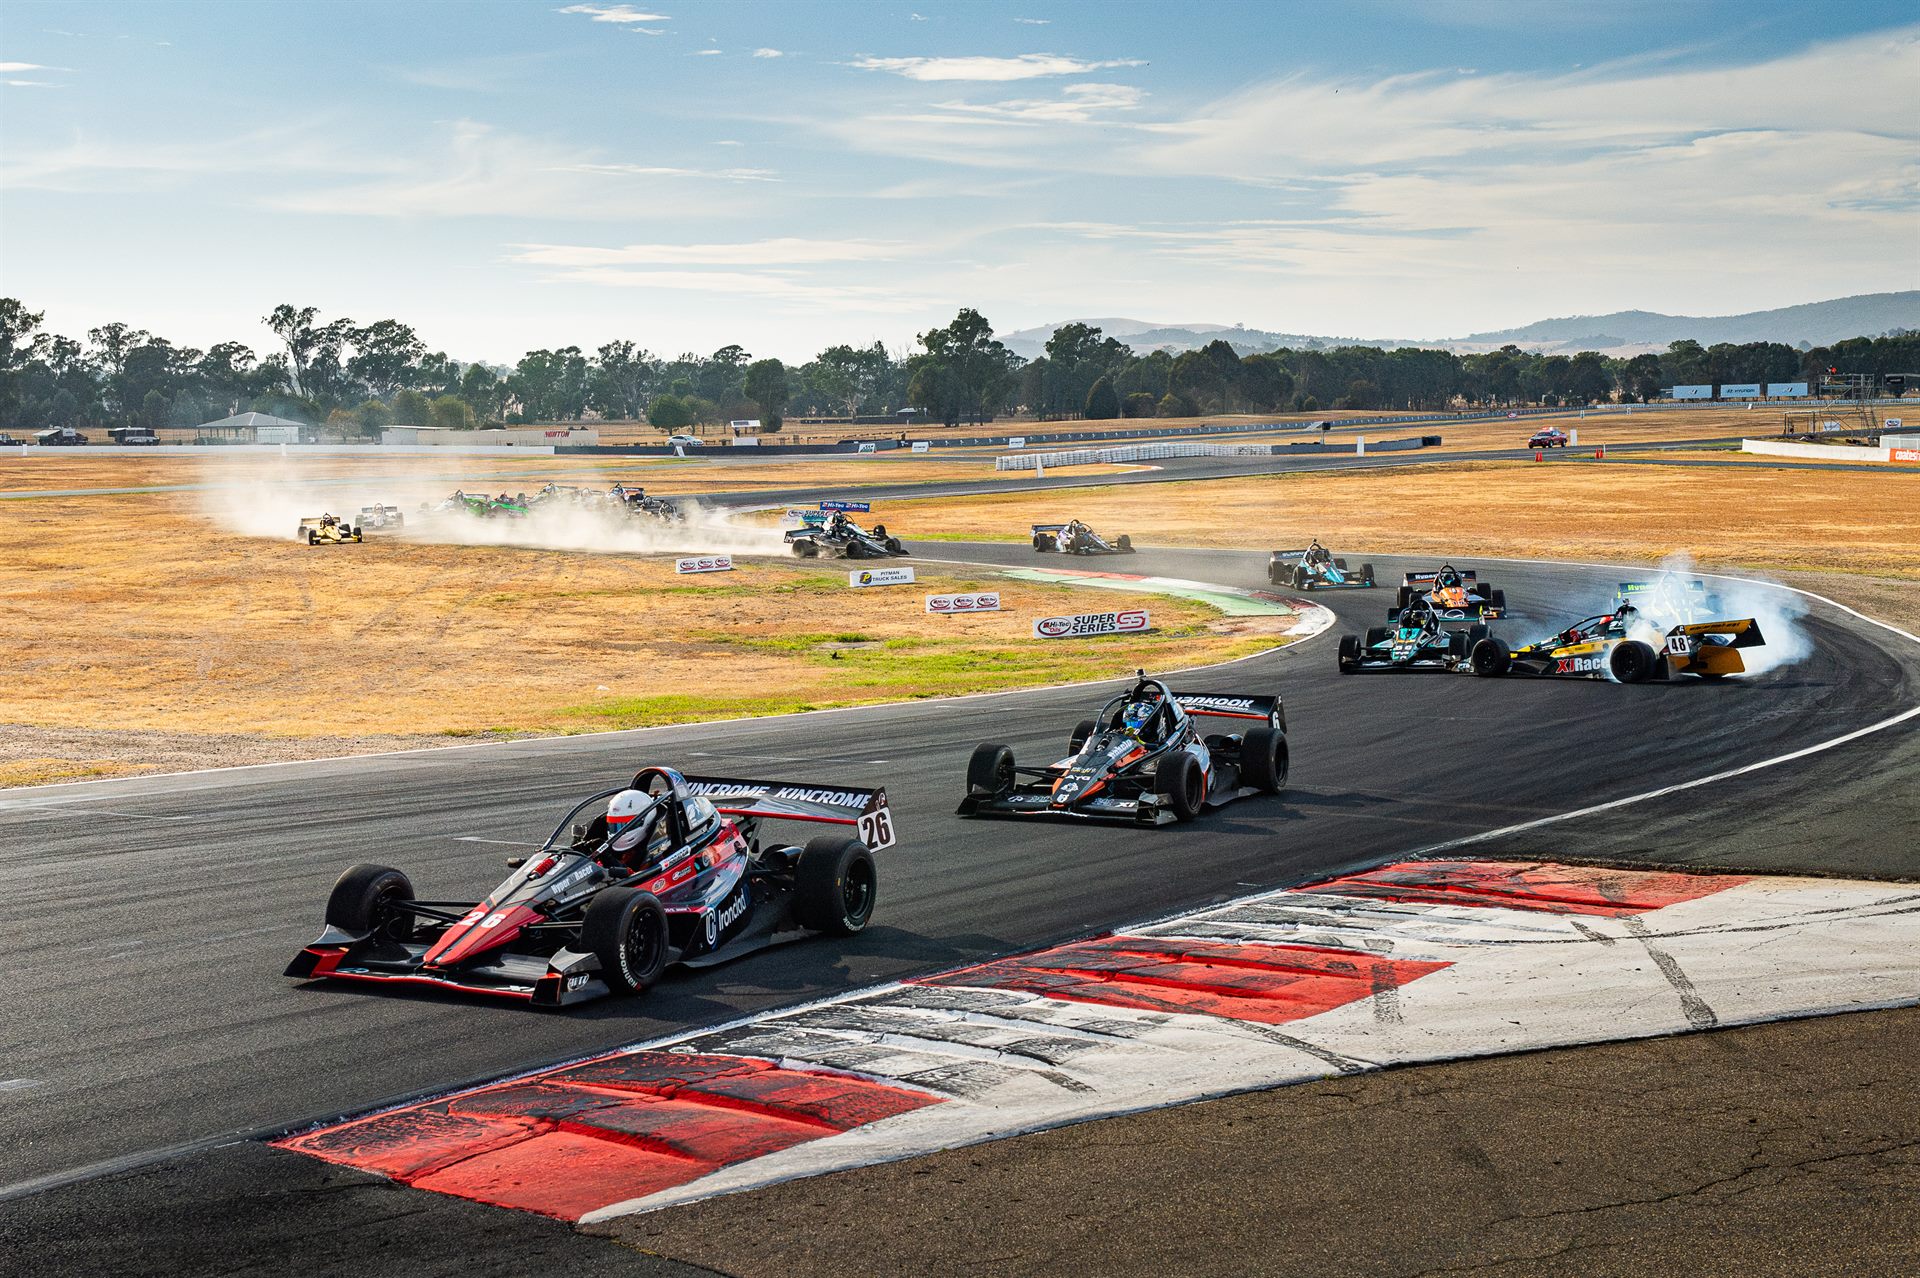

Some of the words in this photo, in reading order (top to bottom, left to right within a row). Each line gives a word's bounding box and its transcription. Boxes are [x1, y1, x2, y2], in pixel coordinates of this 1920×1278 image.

[544, 430, 570, 438] WINTON
[1073, 613, 1115, 625] SUPER
[1071, 622, 1116, 634] SERIES
[1671, 637, 1686, 651] 48
[774, 786, 872, 809] KINCROME
[862, 812, 890, 848] 26
[718, 887, 747, 931] Ironclad
[459, 911, 507, 928] 26
